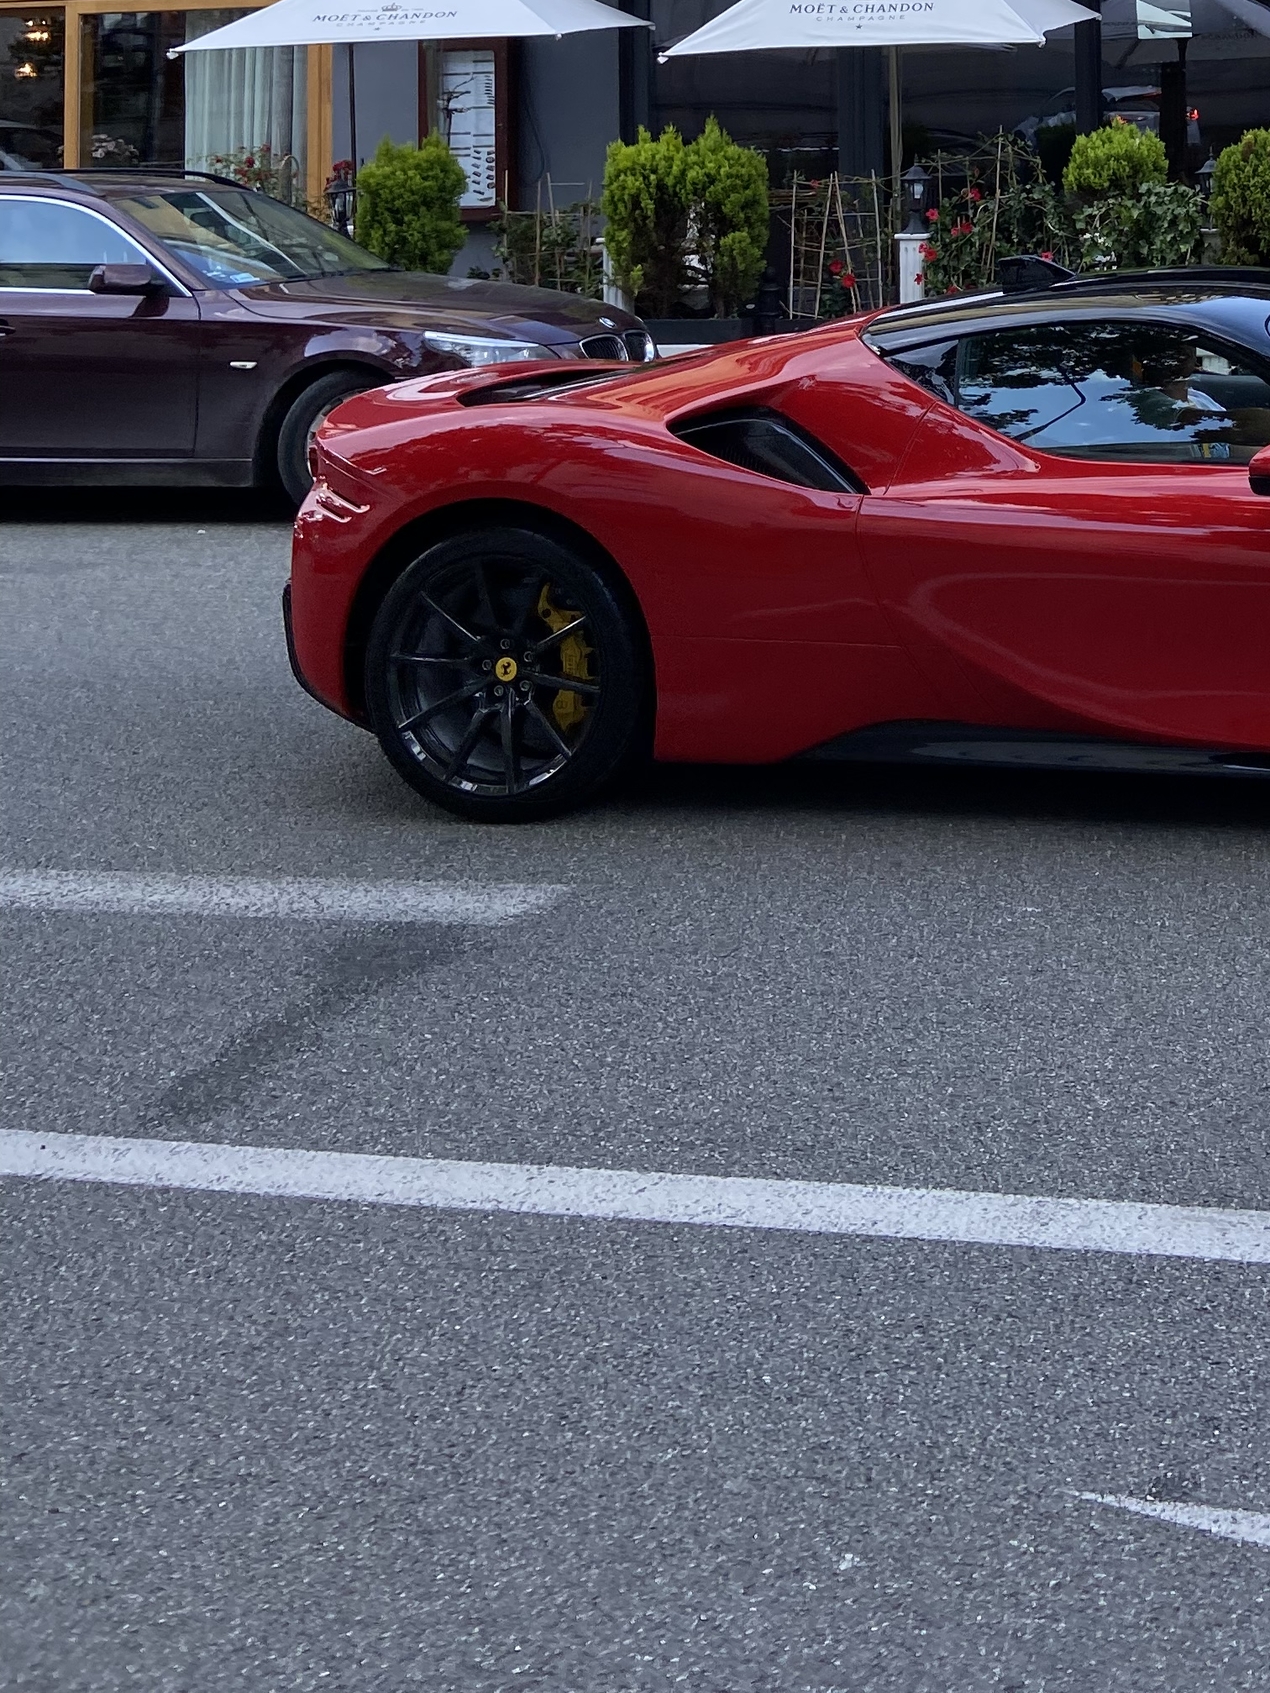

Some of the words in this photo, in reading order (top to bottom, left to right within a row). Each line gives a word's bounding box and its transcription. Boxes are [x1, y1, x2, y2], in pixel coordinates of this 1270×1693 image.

[789, 3, 837, 14] MOËT
[839, 6, 849, 14] &
[853, 2, 935, 13] CHANDON
[376, 11, 458, 20] CHANDON
[816, 14, 906, 22] CHAMPAGNE
